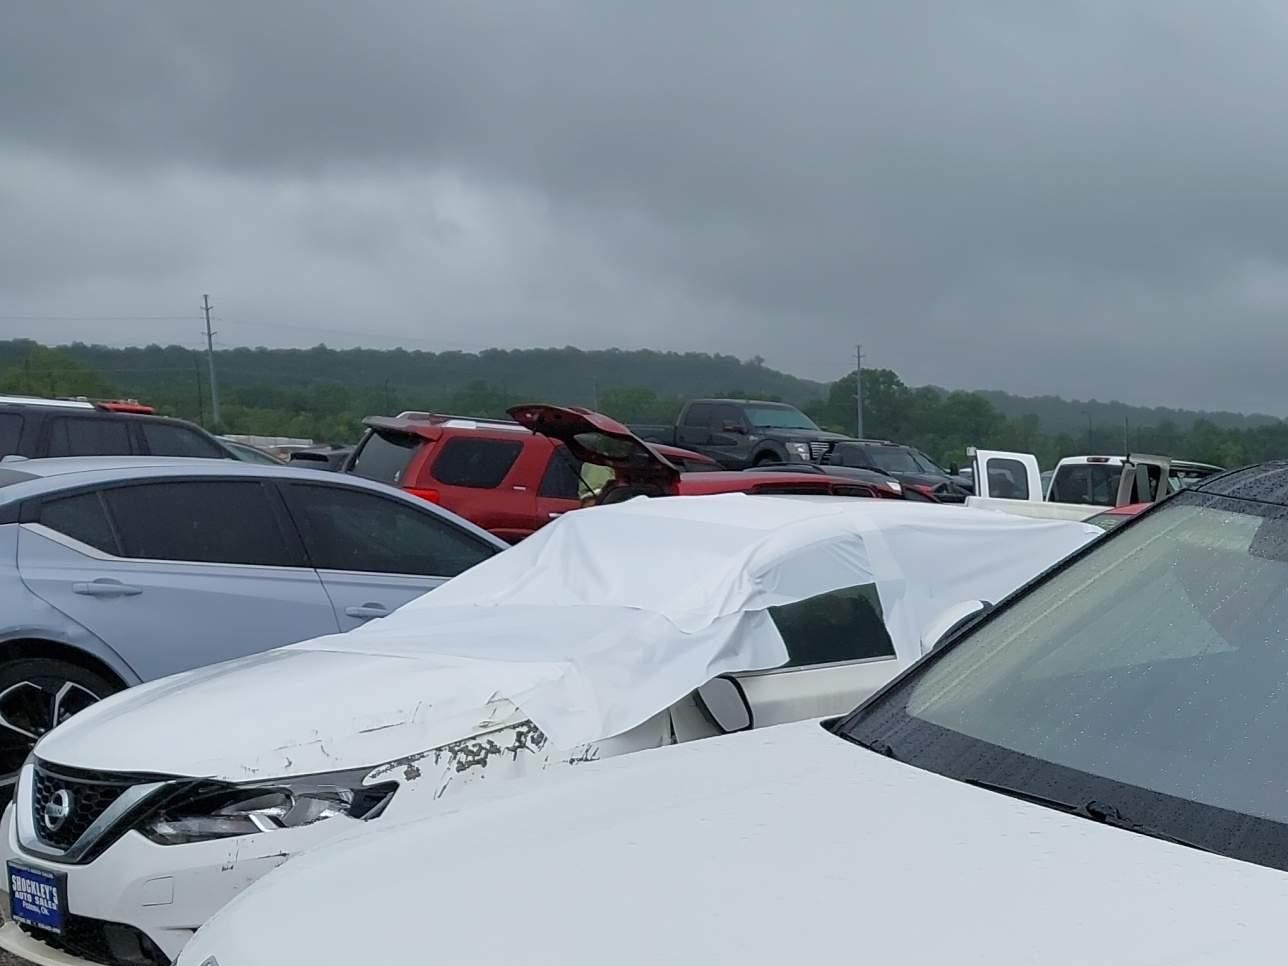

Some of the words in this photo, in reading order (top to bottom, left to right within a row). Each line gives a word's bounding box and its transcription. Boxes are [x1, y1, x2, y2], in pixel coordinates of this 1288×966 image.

[12, 874, 59, 905] SHOCKLEY'S
[15, 891, 33, 903] AUTO
[34, 896, 57, 910] SALES
